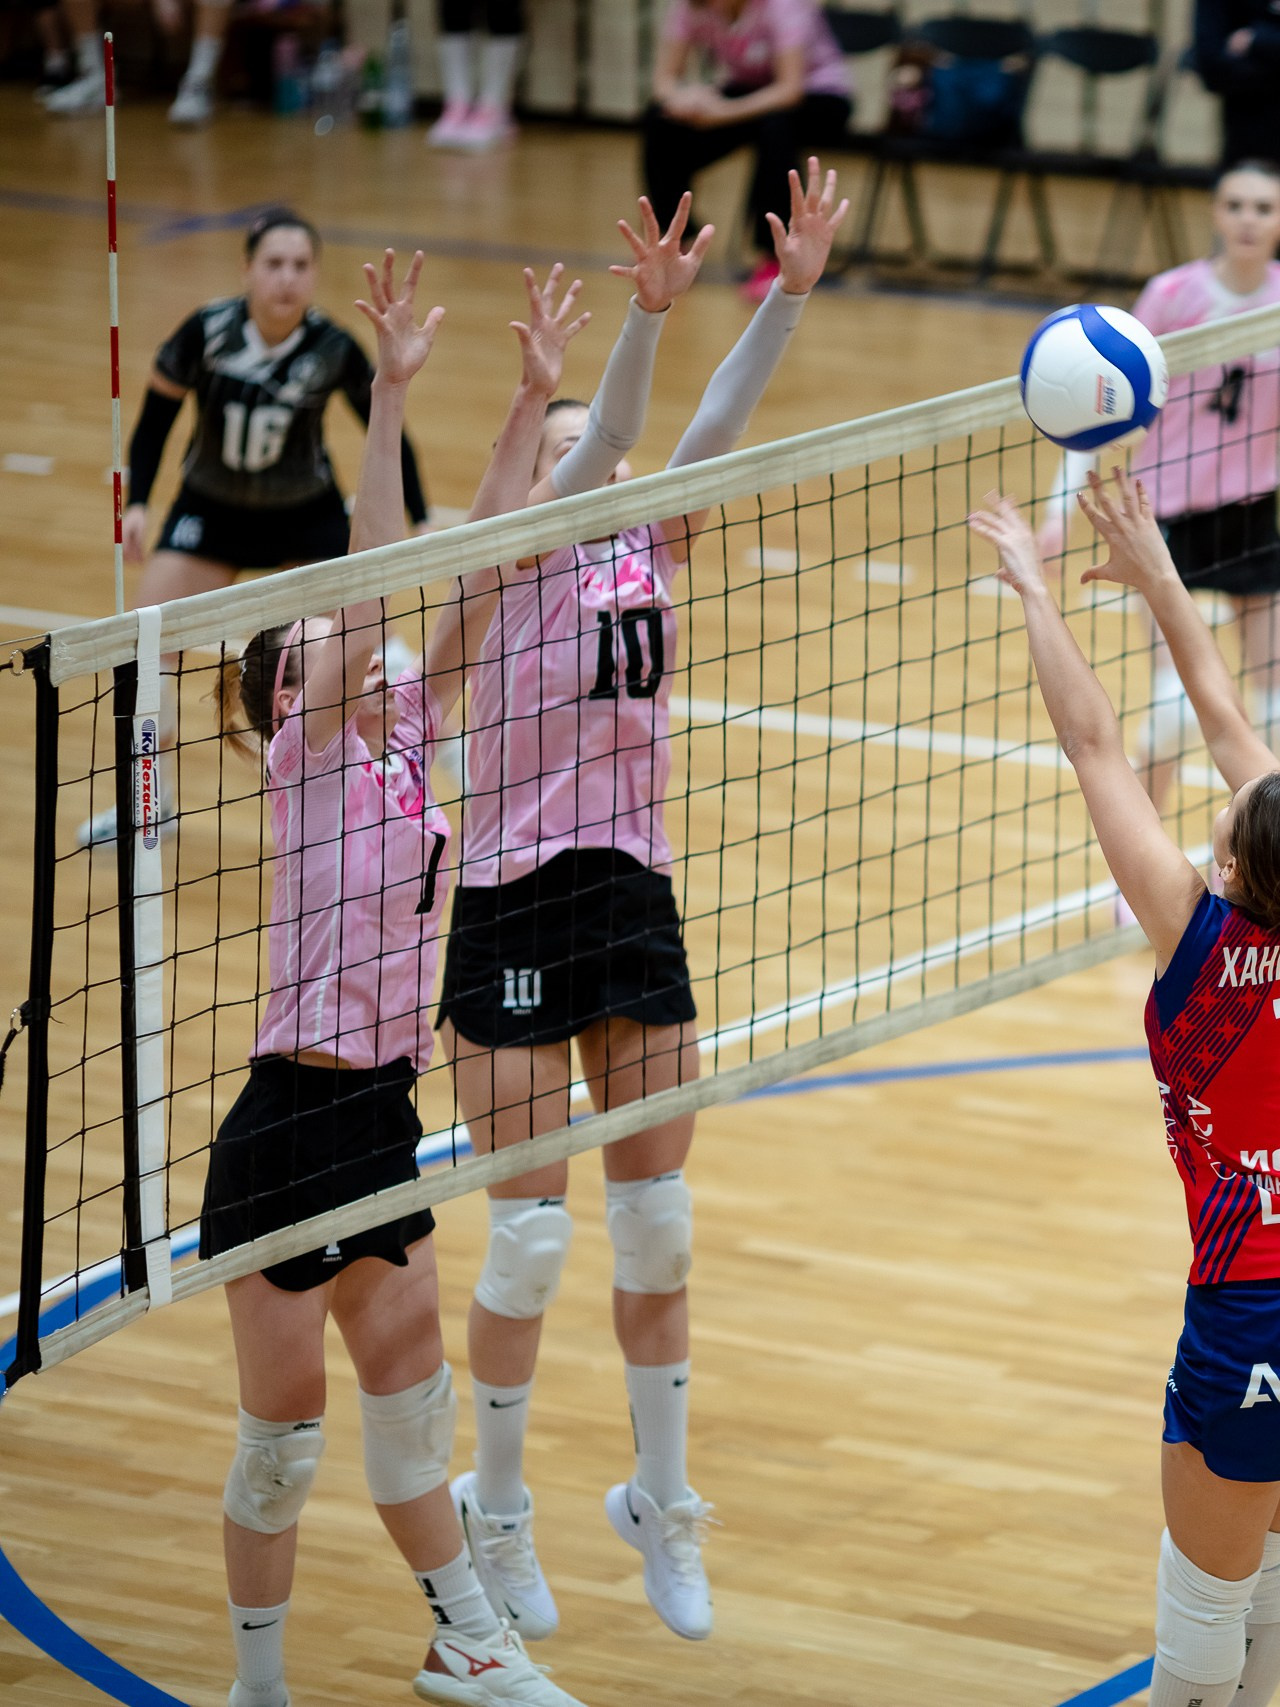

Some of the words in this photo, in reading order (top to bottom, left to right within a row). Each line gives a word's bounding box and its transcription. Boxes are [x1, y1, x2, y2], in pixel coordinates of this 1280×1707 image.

[222, 402, 294, 472] 16
[589, 608, 665, 700] 10
[502, 967, 542, 1009] 10
